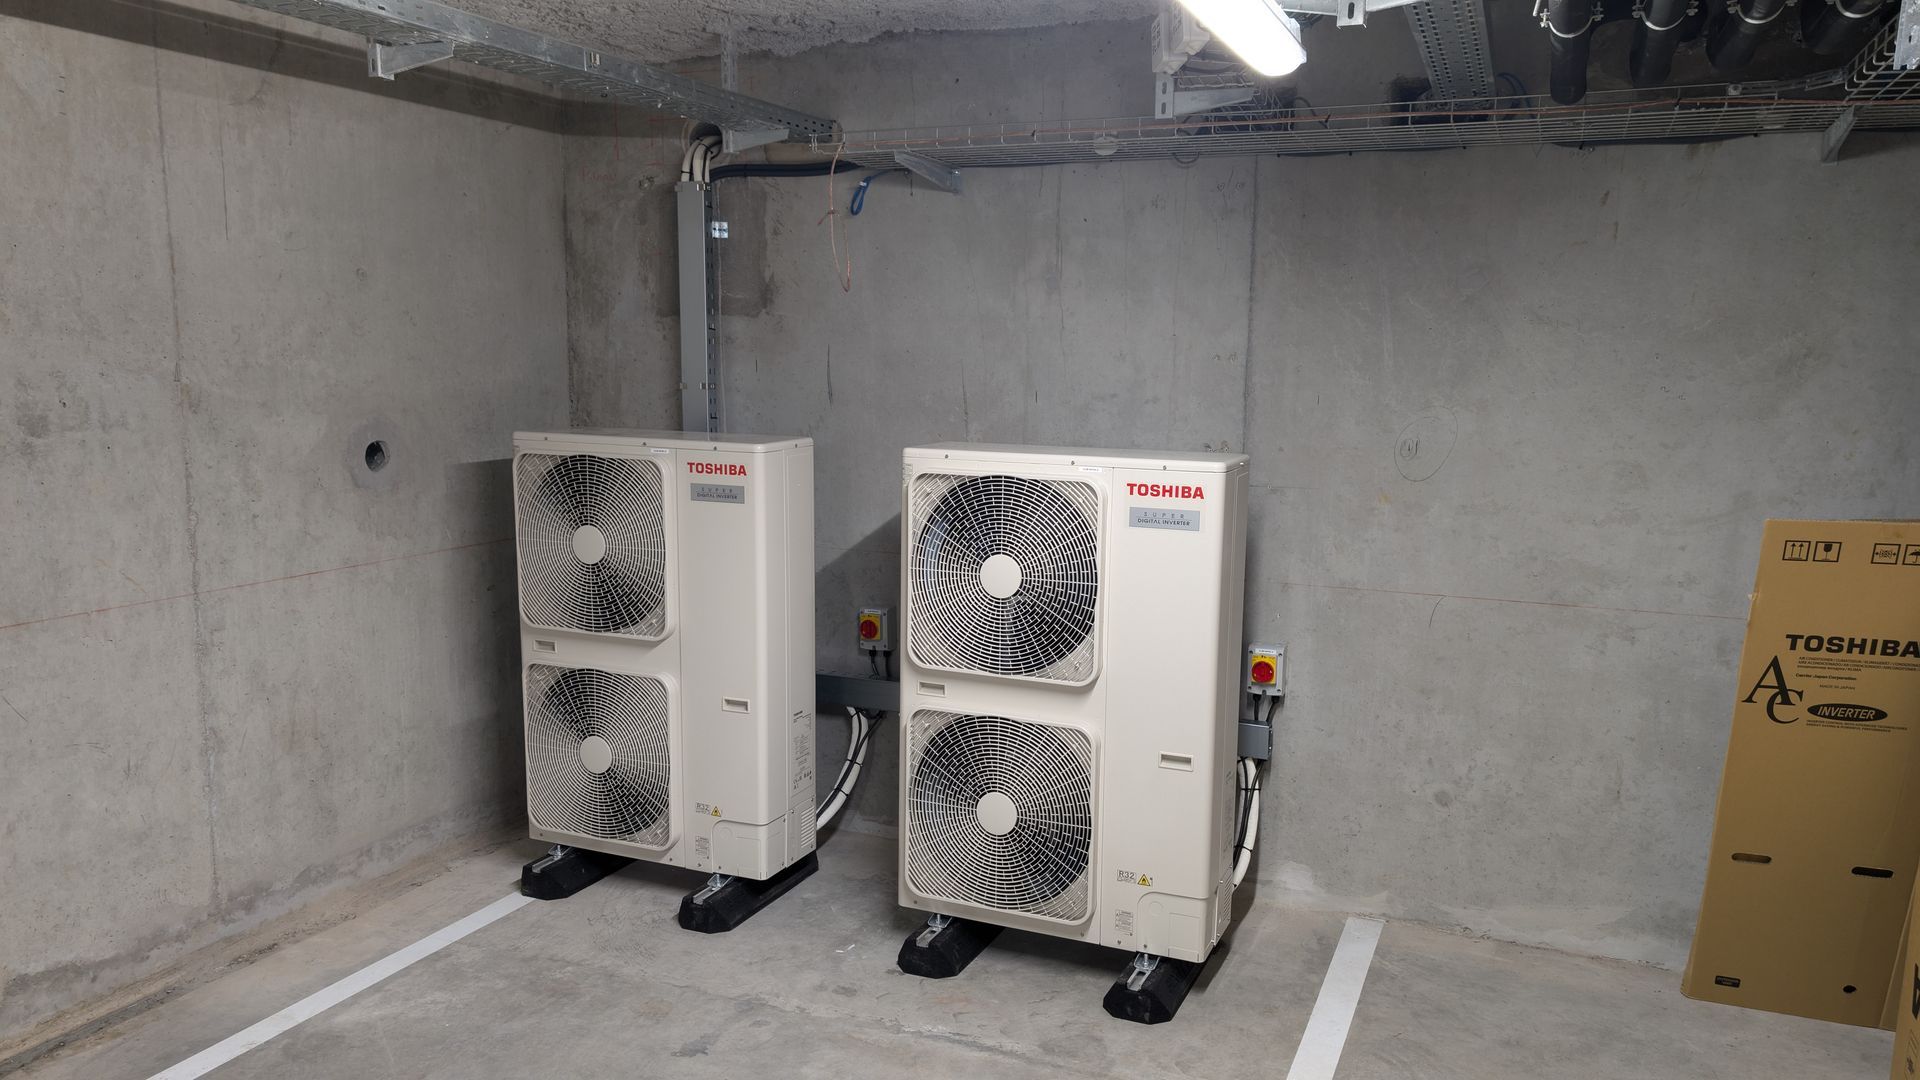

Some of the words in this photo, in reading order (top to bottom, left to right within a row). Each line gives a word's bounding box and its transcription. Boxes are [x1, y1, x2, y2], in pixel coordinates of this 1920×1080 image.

[687, 462, 747, 476] TOSHIBA
[1127, 483, 1205, 500] TOSHIBA
[1786, 634, 1920, 658] TOSHIBA
[1817, 706, 1876, 720] INVERTER
[1118, 870, 1135, 879] R32
